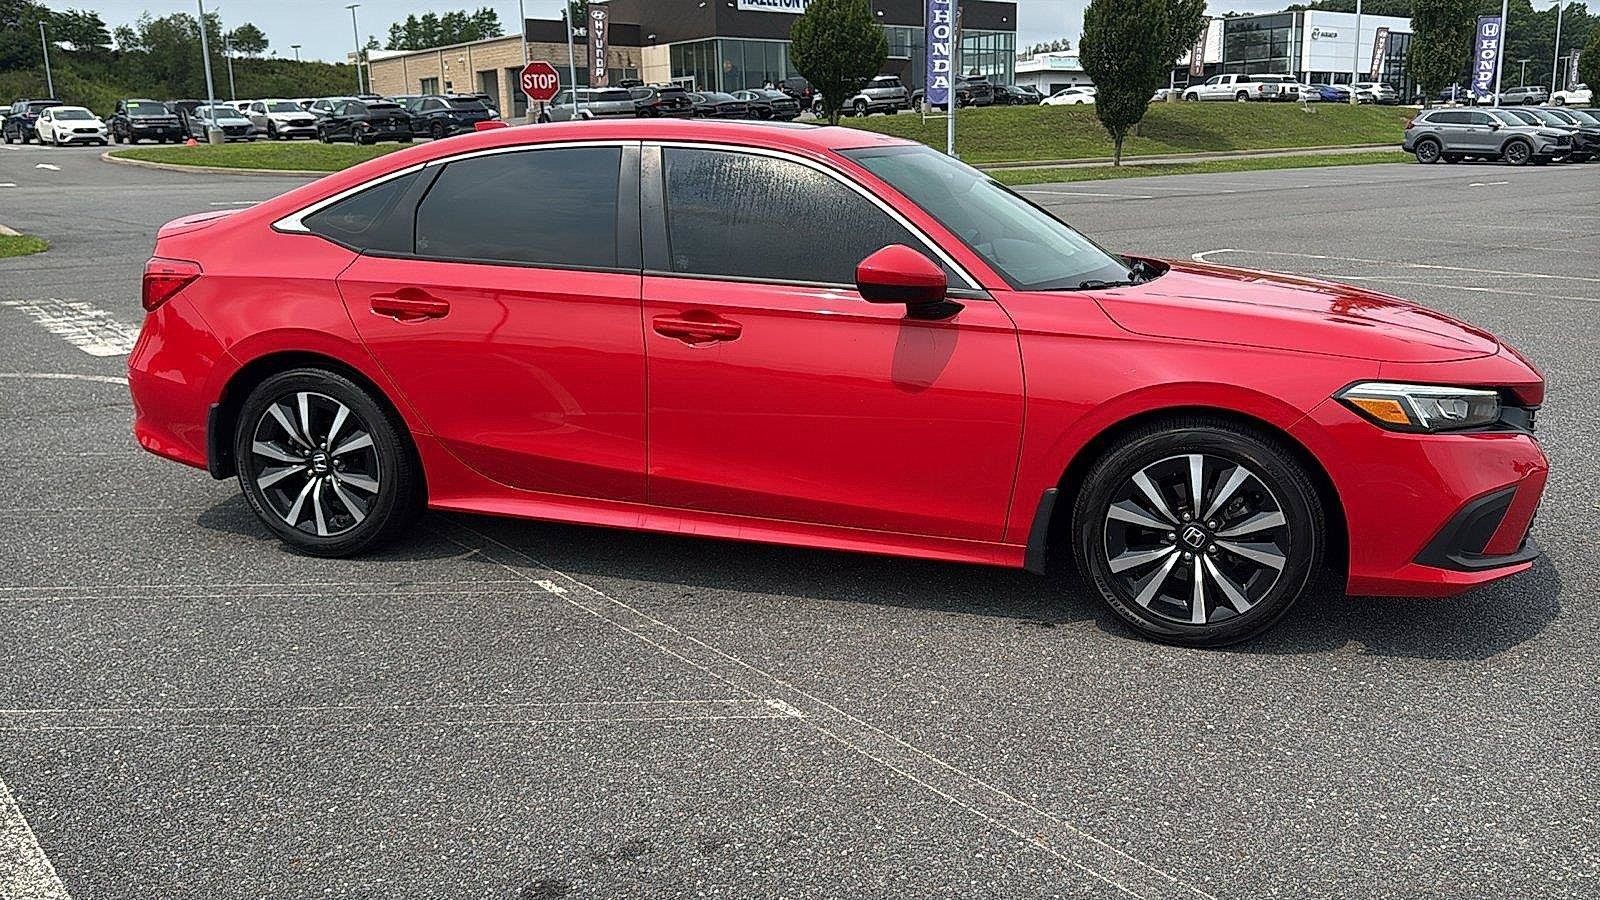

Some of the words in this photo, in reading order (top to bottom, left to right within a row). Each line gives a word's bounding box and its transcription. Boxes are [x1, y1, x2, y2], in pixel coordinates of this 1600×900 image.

[594, 20, 605, 84] HYUNDAI
[931, 10, 950, 88] HONDA
[1477, 40, 1497, 90] HONDA
[523, 74, 557, 89] STOP
